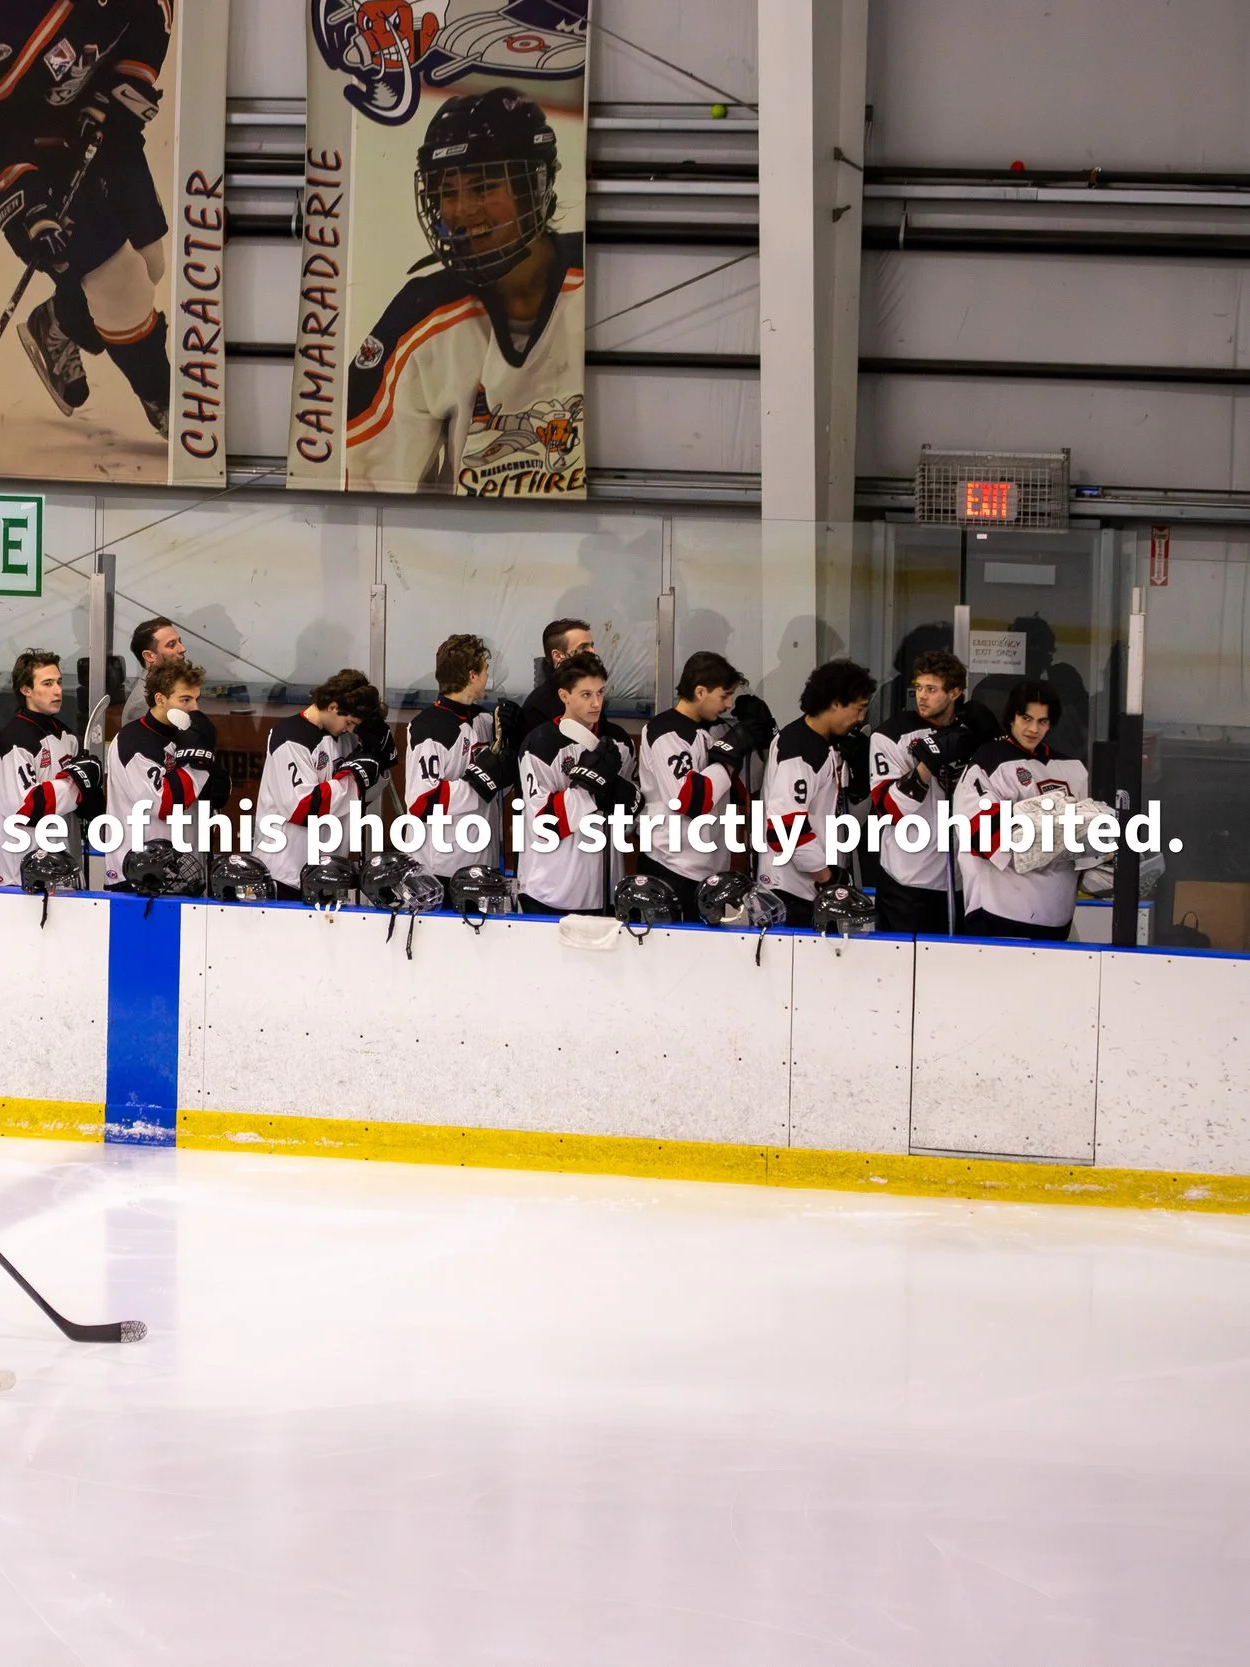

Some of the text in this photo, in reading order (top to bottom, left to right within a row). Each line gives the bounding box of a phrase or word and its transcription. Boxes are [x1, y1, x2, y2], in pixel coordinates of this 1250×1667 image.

[180, 169, 224, 459] CHARACTER
[297, 148, 344, 463] CAMARADERIE
[966, 482, 1010, 519] EXIT
[418, 754, 440, 781] 10
[667, 750, 693, 780] 23
[793, 778, 808, 804] 9
